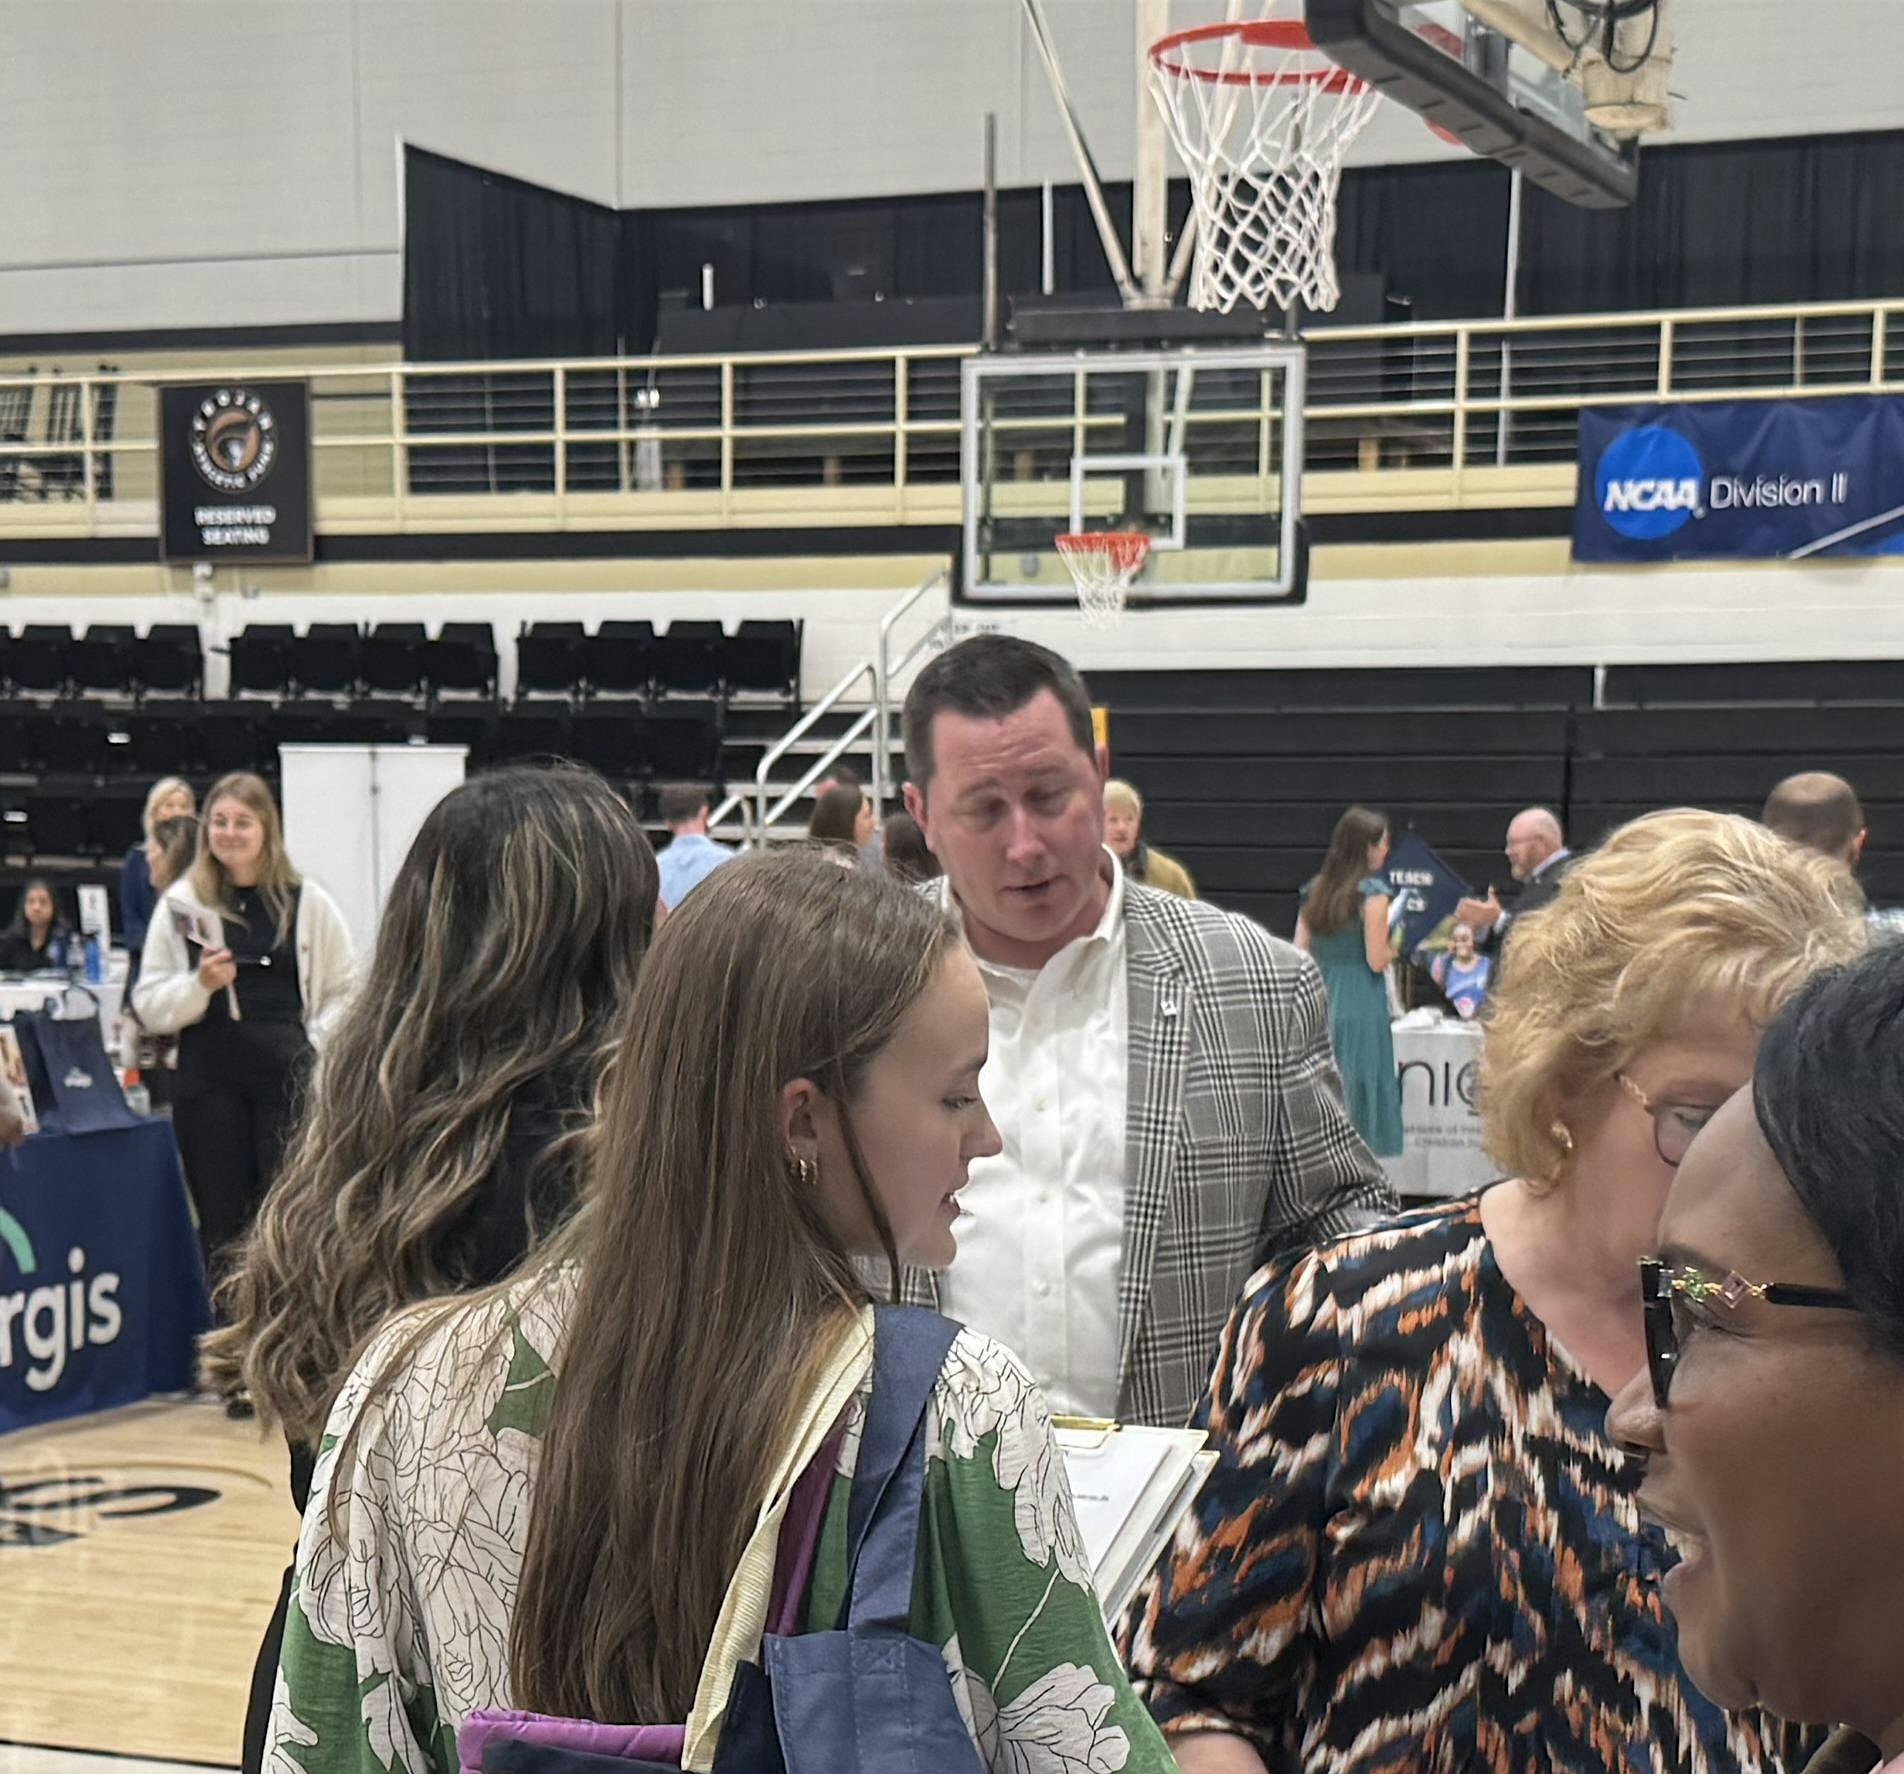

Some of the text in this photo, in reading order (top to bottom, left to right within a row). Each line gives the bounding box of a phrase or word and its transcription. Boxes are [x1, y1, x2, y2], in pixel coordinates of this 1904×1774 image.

[1604, 472, 1847, 512] NCAA Division II
[194, 505, 277, 526] RESERVED
[201, 526, 270, 546] SEATING
